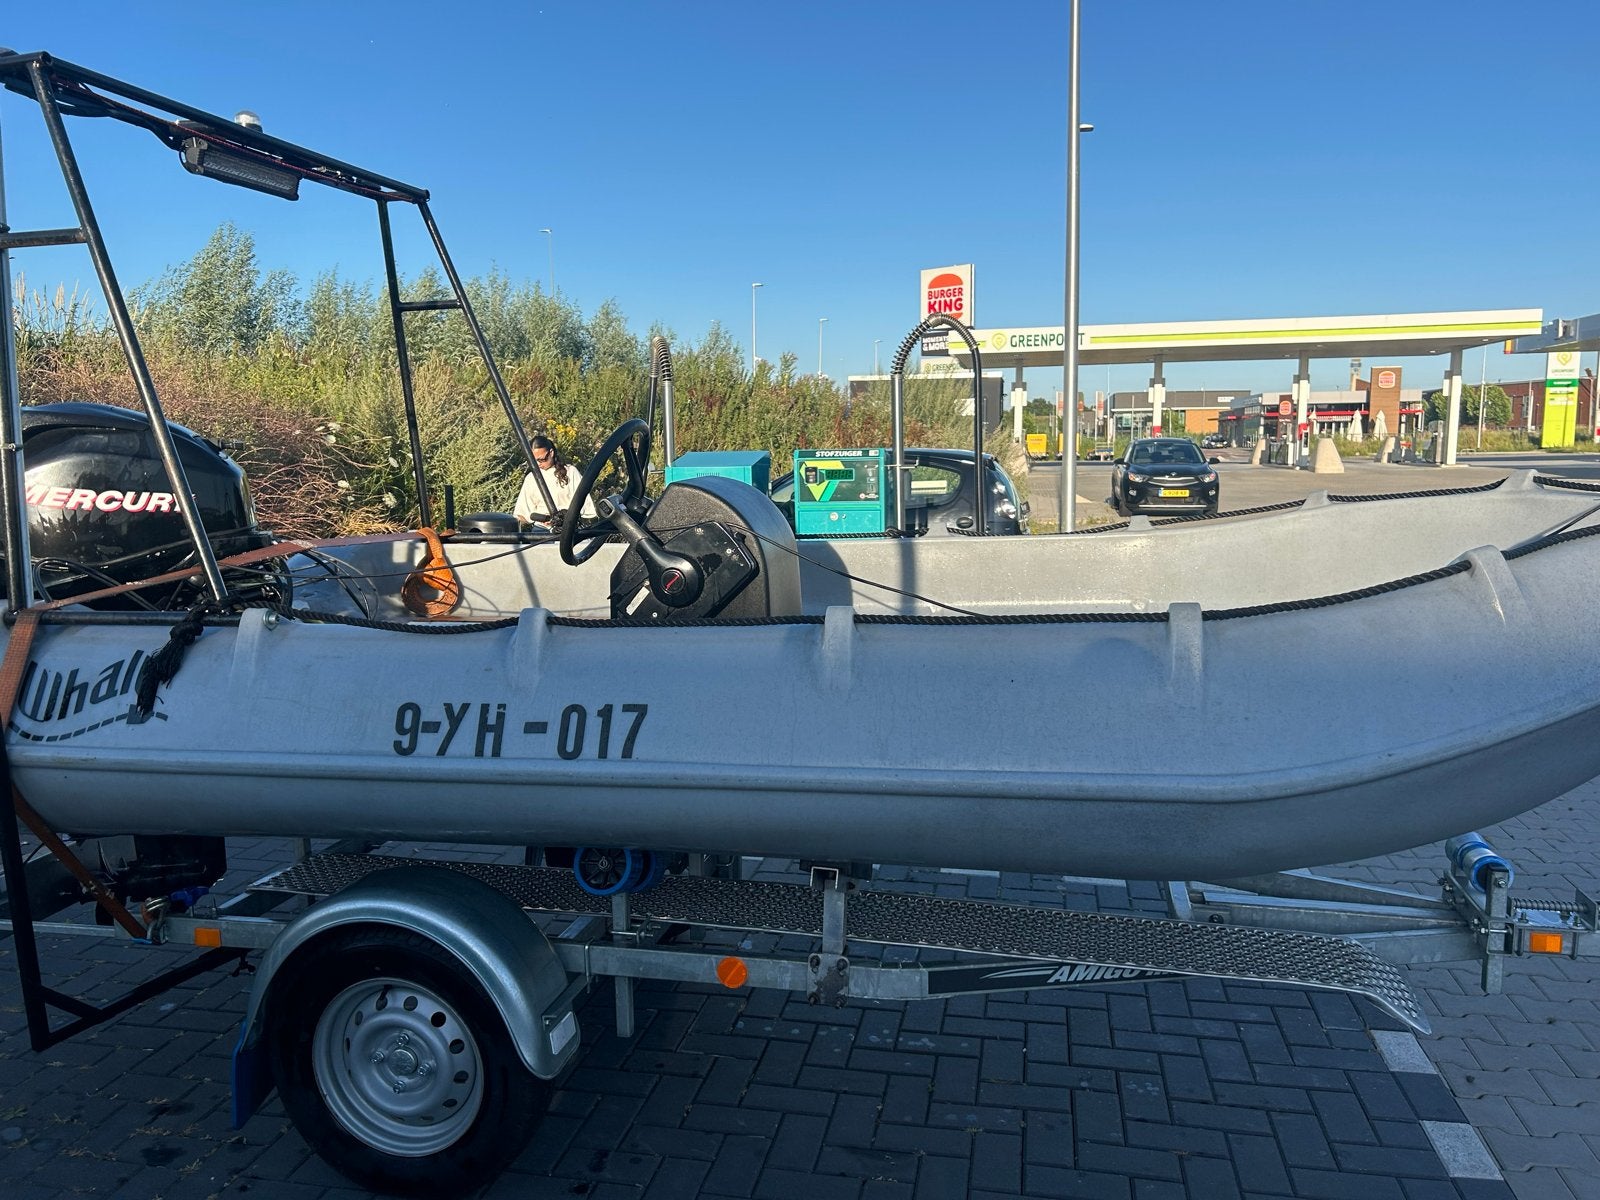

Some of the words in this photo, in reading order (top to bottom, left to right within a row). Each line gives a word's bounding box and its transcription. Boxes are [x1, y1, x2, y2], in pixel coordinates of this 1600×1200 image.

[928, 287, 963, 300] BURGER
[928, 298, 963, 314] KING
[1010, 333, 1085, 348] GREENPOT
